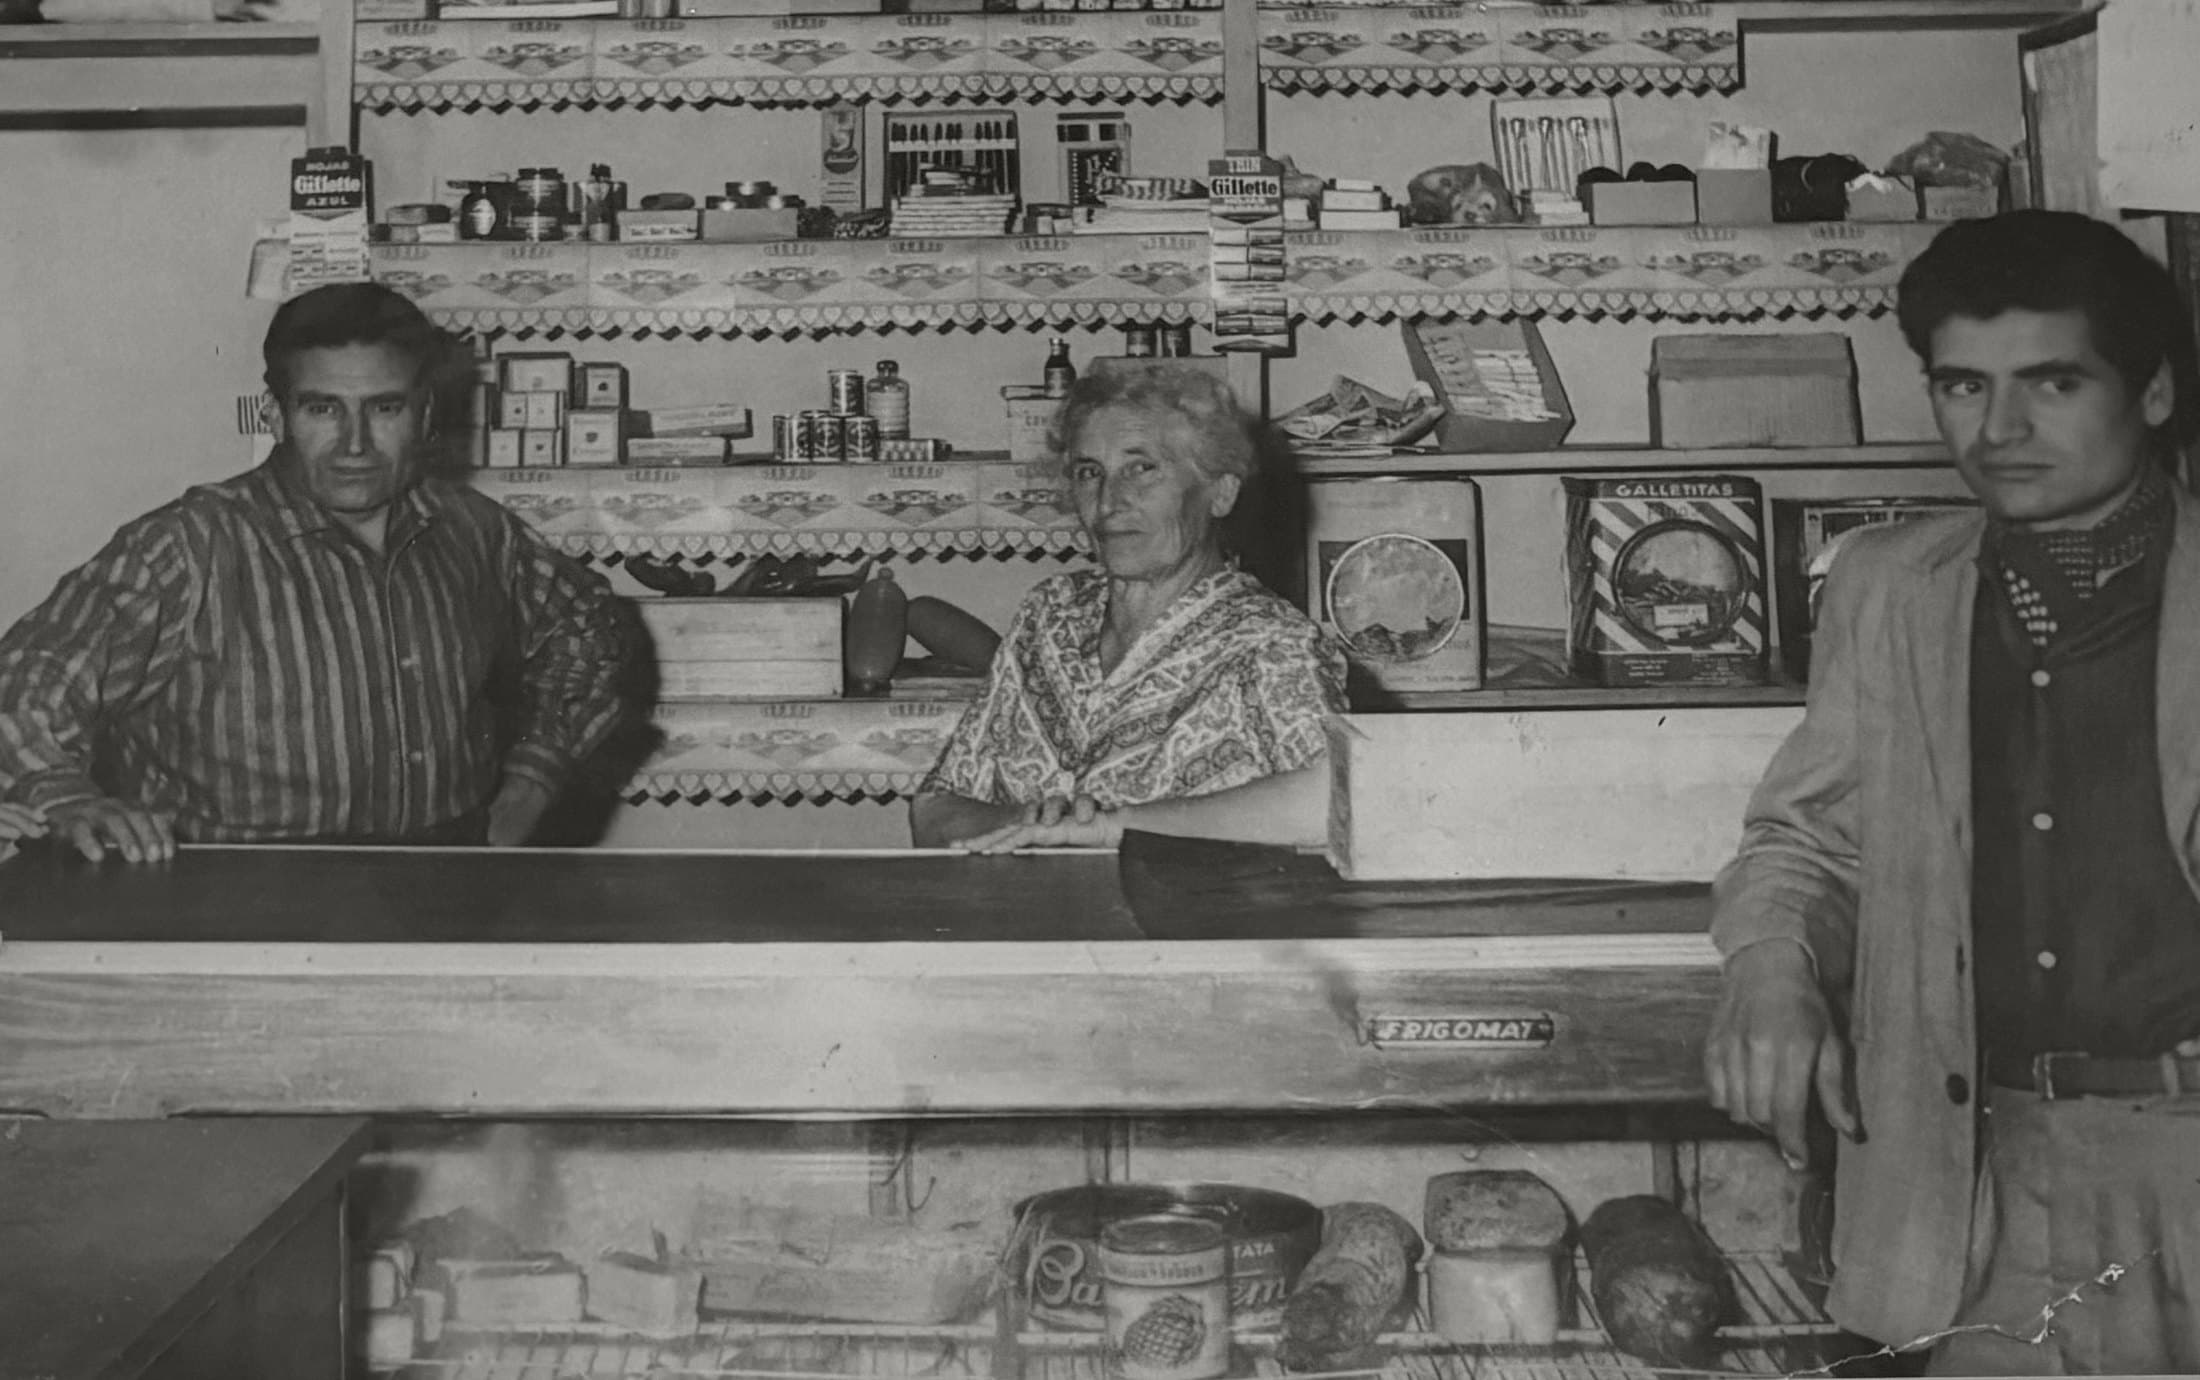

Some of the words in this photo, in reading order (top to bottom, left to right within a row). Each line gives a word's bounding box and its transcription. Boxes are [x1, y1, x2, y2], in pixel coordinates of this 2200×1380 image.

[294, 175, 361, 195] Gillette
[1211, 178, 1278, 196] Gillette
[305, 196, 350, 206] AZUL
[1616, 483, 1733, 497] GALLETITAS
[1376, 1021, 1534, 1040] FRIGOMAT
[1232, 1241, 1276, 1259] TATA
